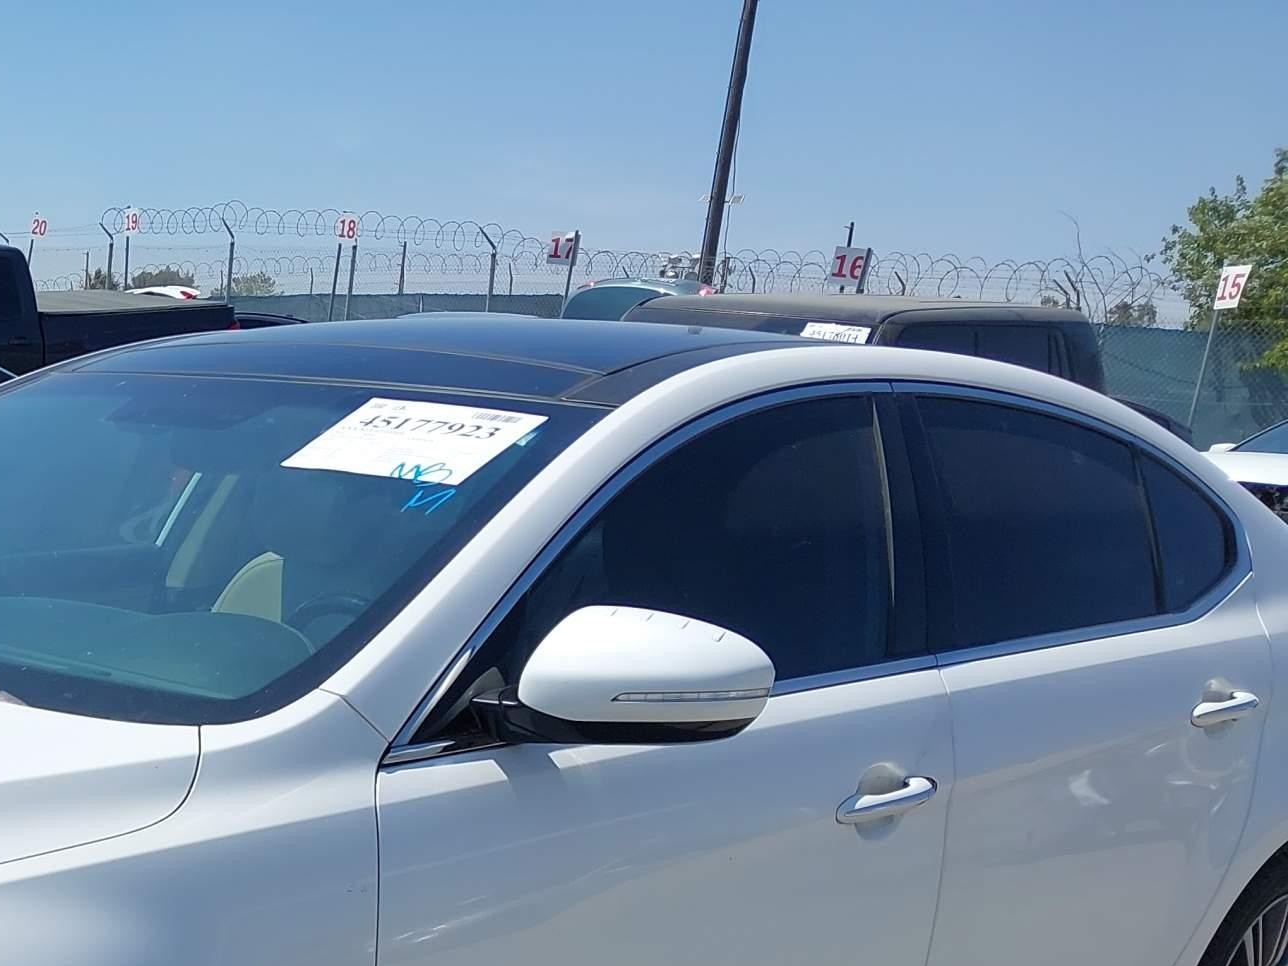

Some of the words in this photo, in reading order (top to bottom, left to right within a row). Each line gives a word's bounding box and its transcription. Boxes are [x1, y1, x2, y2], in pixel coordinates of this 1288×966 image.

[32, 219, 47, 236] 20
[125, 213, 138, 231] 19
[338, 219, 356, 239] 18
[549, 237, 574, 259] 17
[831, 254, 865, 280] 16
[1216, 272, 1247, 301] 15
[359, 414, 501, 440] 45177923
